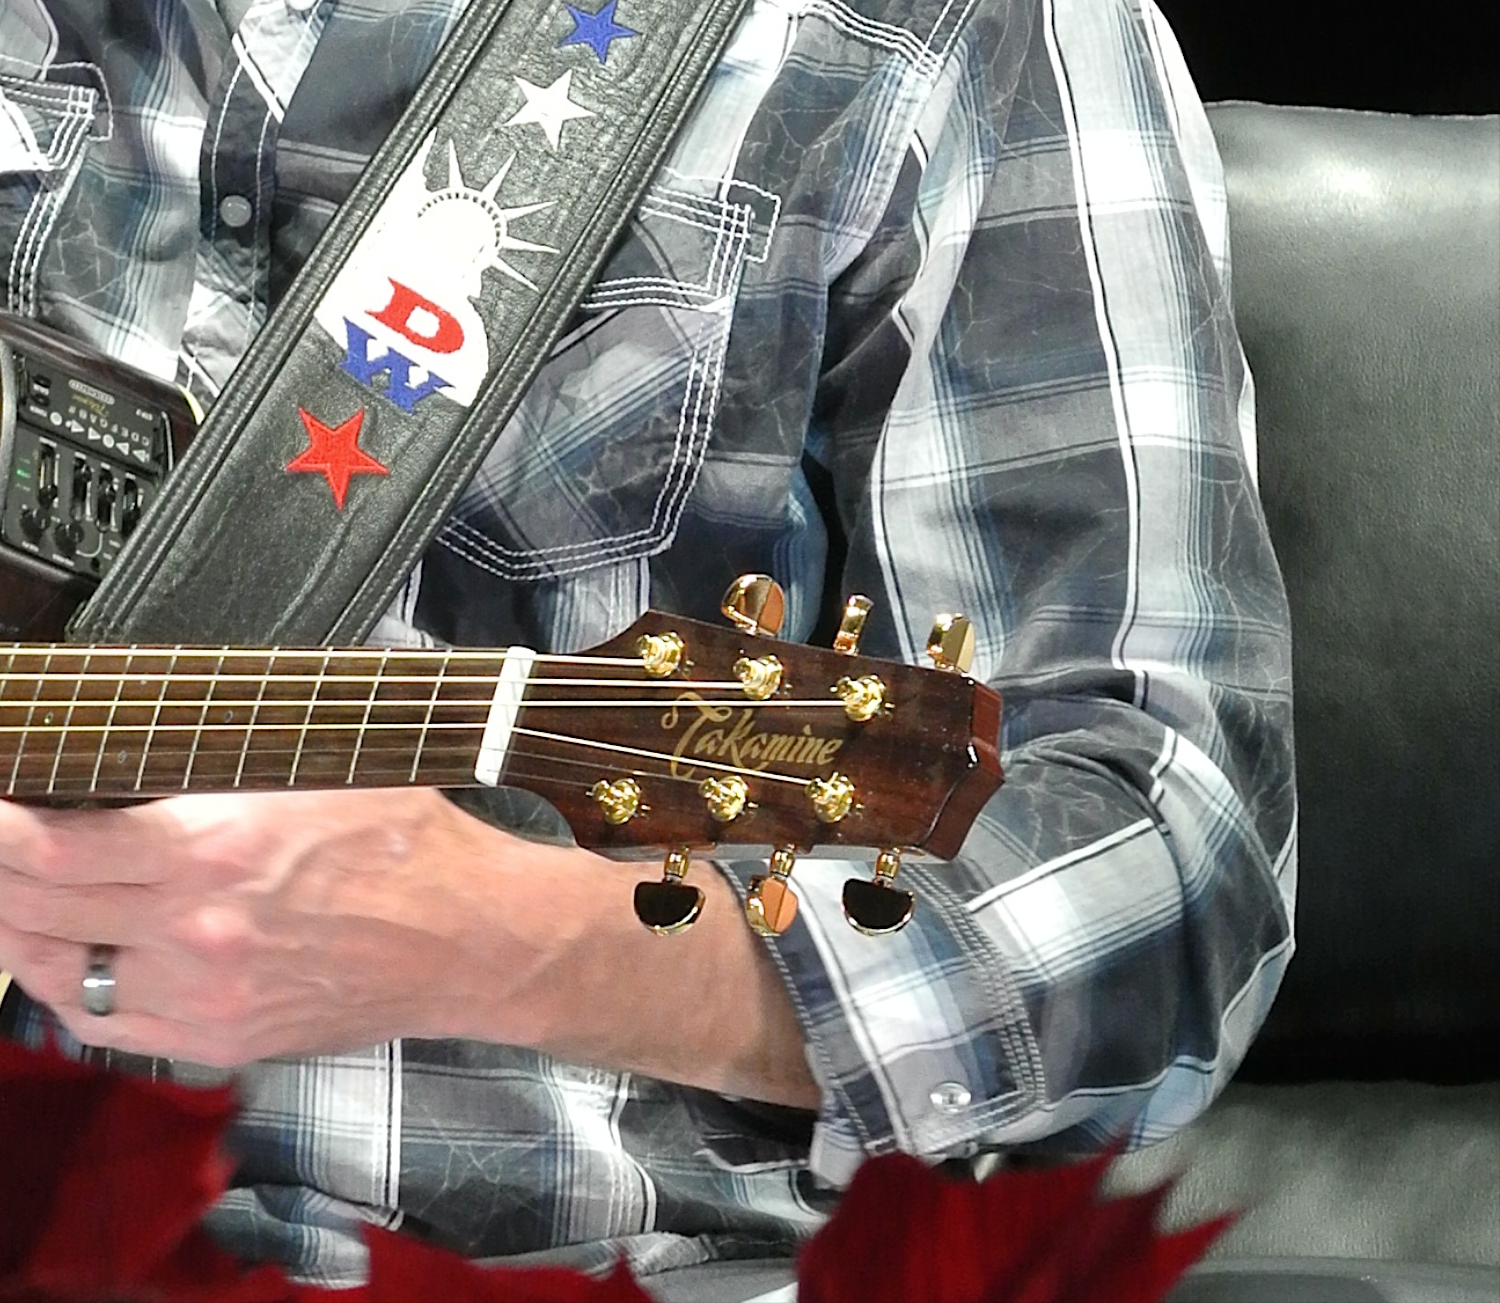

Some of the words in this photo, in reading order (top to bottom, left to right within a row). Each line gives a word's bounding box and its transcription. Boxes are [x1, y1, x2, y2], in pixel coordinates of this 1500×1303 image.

[364, 276, 465, 354] D
[339, 316, 456, 416] W
[661, 691, 844, 779] Takamine
